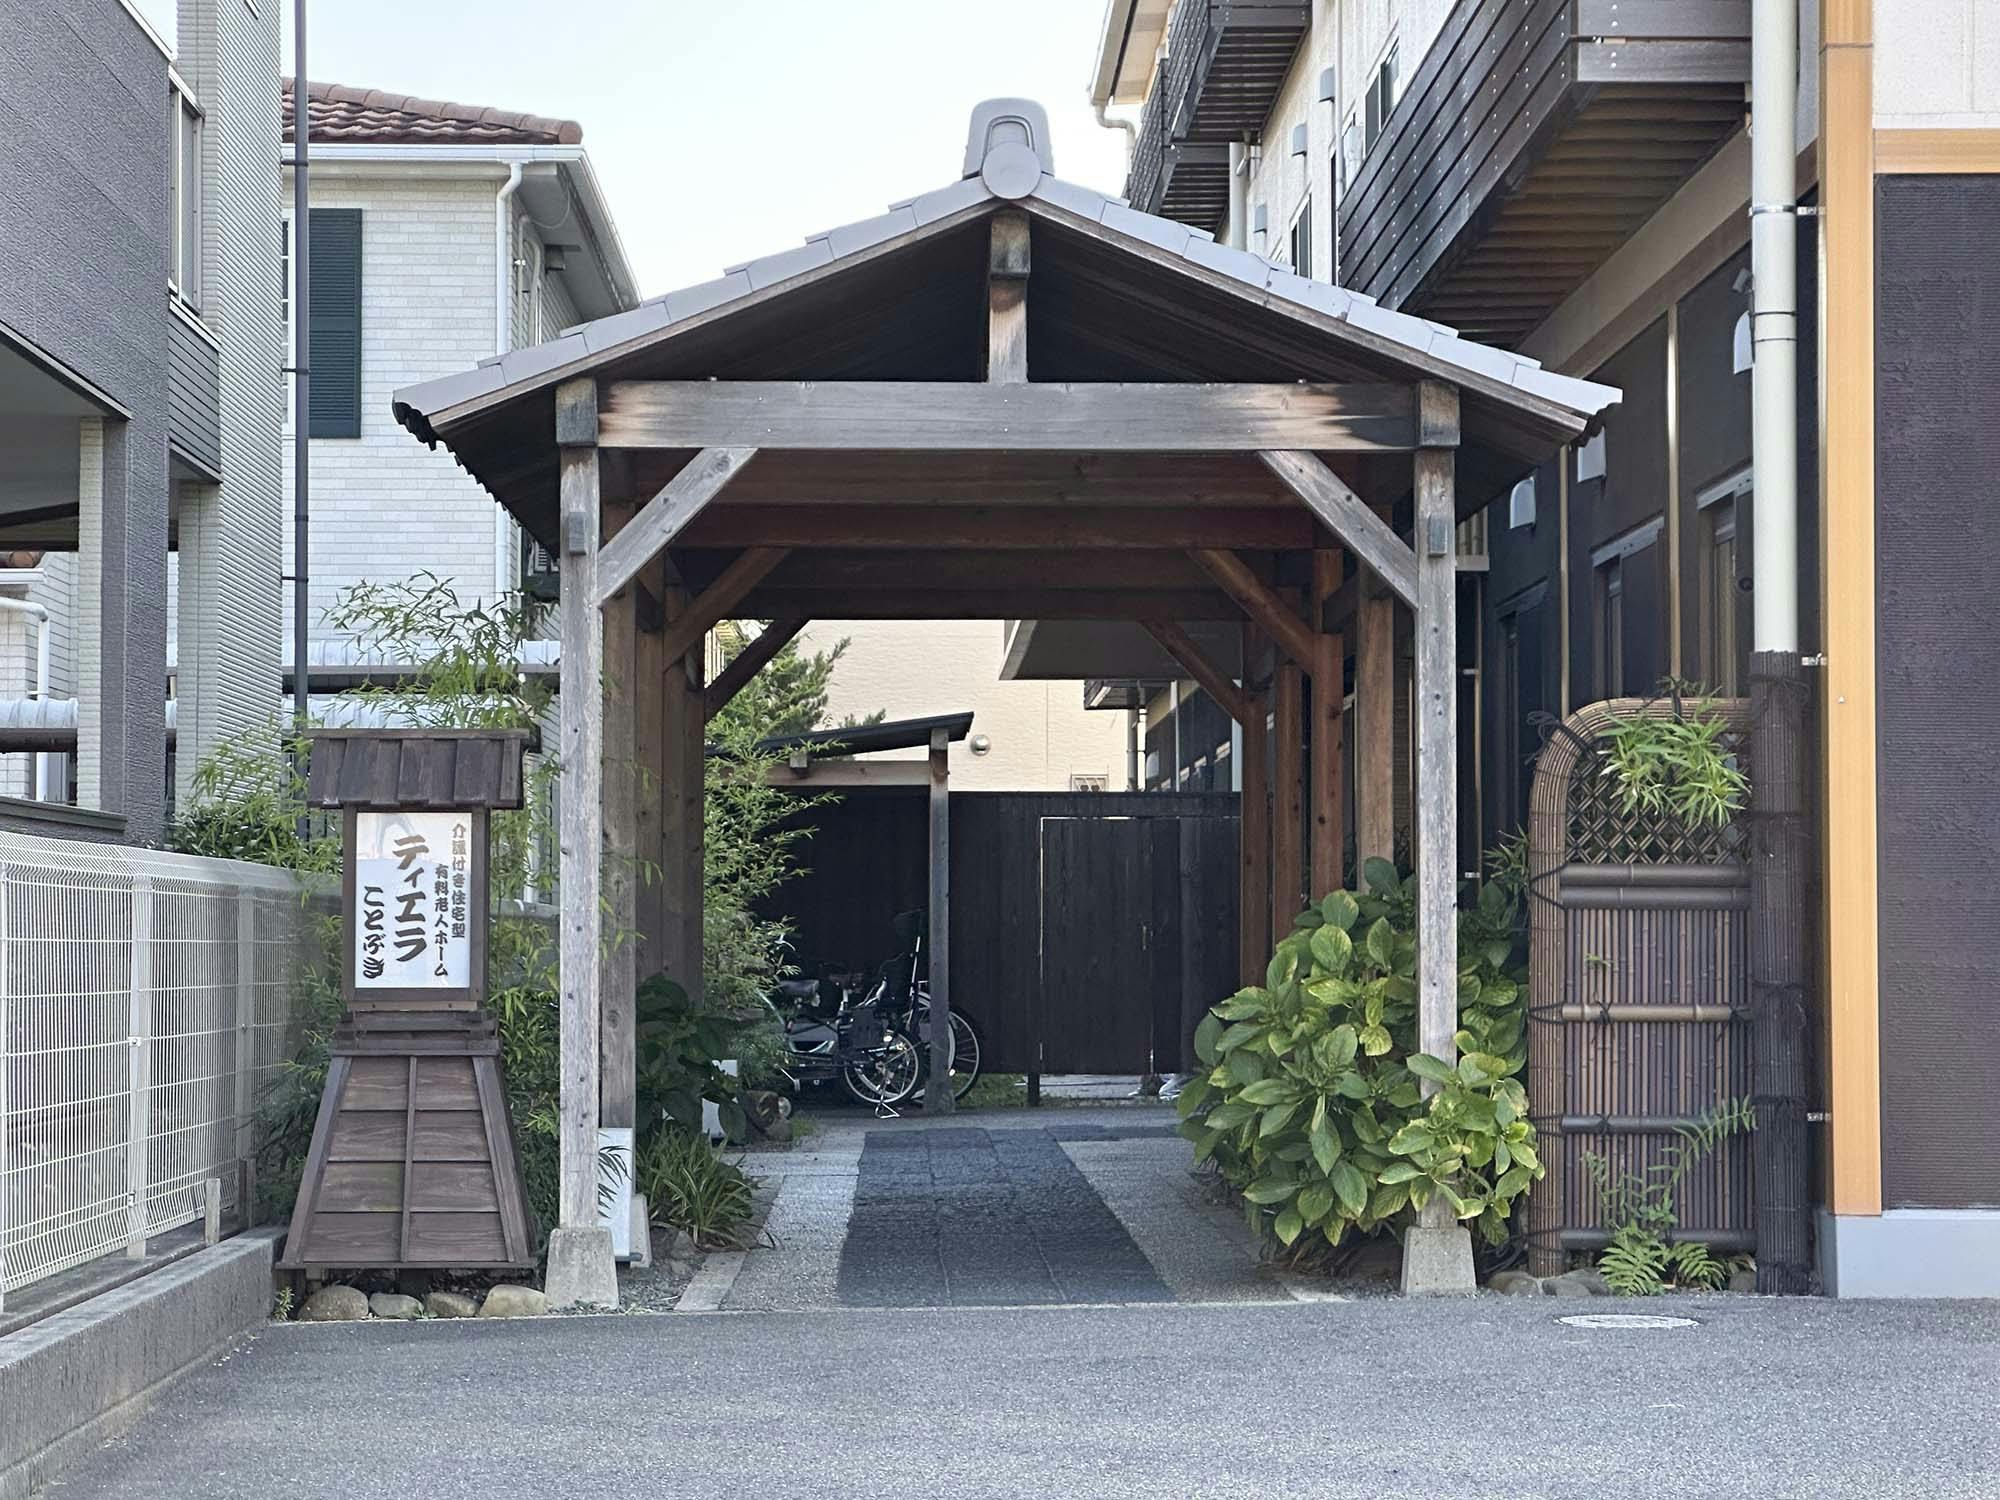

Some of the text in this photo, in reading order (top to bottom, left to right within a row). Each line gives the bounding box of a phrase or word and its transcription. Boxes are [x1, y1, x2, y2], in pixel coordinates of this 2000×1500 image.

[362, 885, 385, 980] ことぶき
[392, 834, 430, 963] ティエラ
[434, 863, 449, 977] 有料老人ホーム
